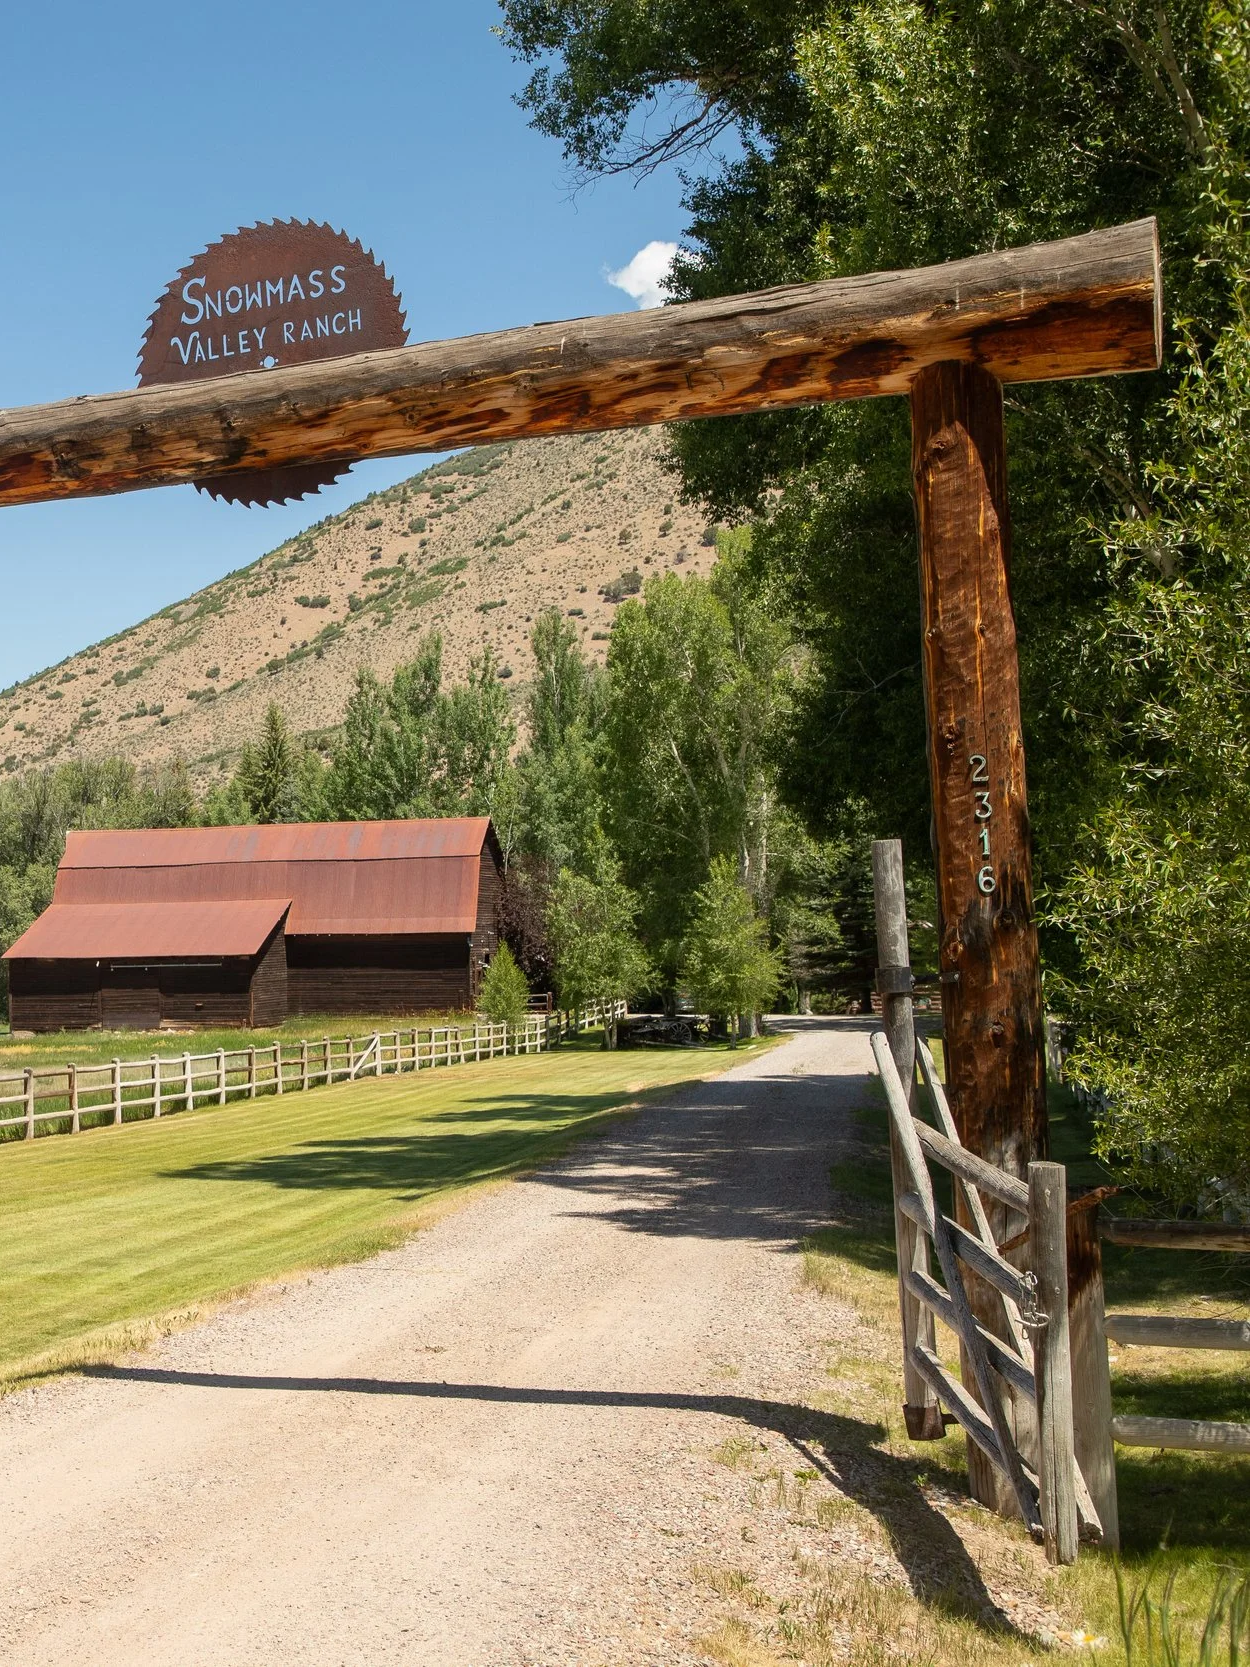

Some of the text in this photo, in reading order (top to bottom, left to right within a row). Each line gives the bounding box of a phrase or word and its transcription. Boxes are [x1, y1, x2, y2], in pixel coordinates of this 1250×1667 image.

[181, 265, 346, 325] SNOWMASS
[170, 308, 362, 365] VALLEY RANCH
[969, 754, 997, 893] 2316
